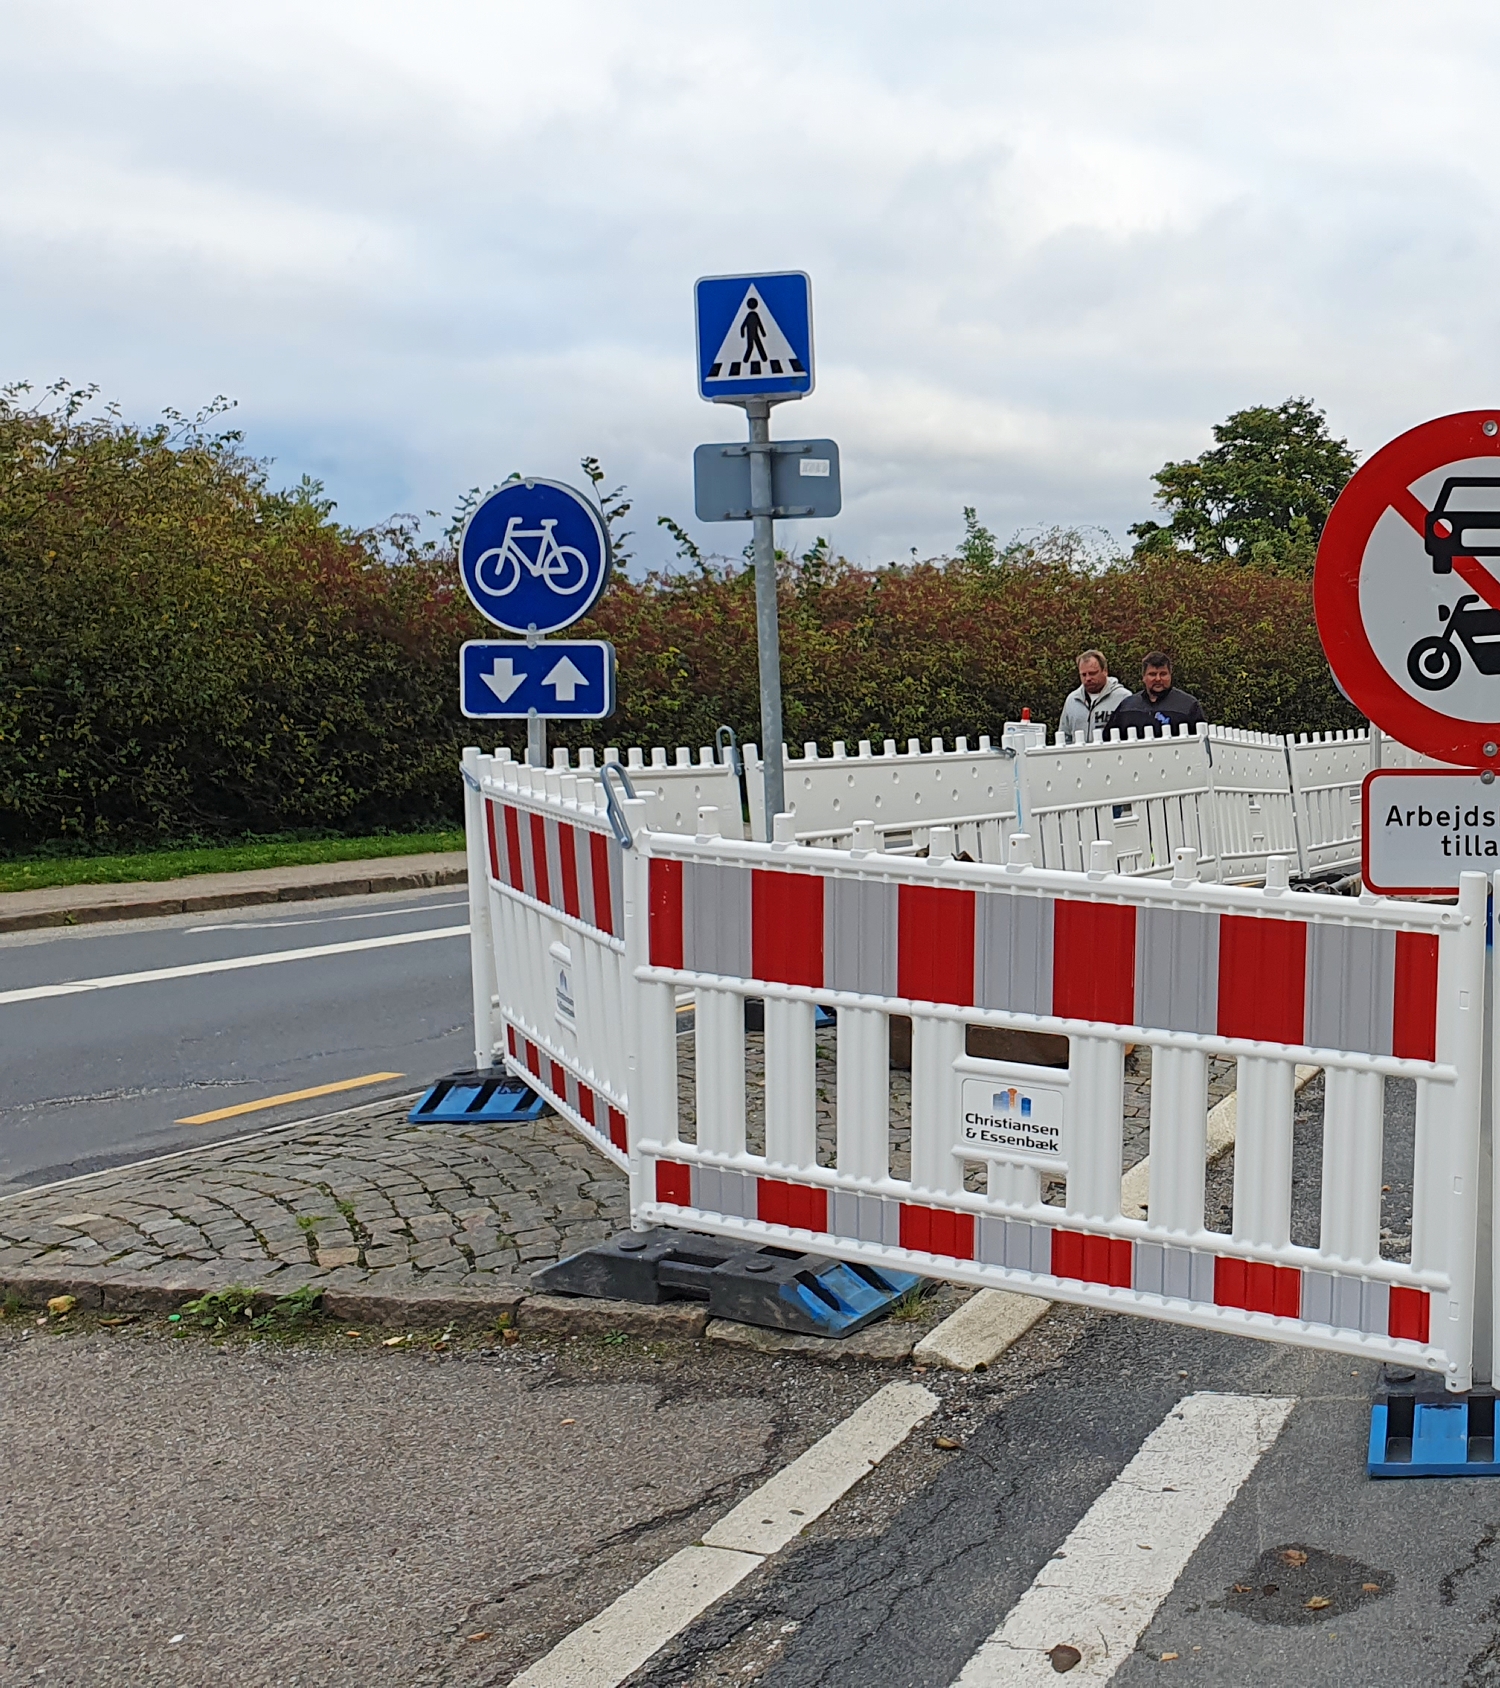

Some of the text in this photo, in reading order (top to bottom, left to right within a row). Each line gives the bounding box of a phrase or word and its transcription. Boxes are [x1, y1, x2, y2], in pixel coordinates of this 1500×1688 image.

[965, 1113, 1059, 1136] Christiansen
[966, 1128, 1059, 1151] & Essenbæk
